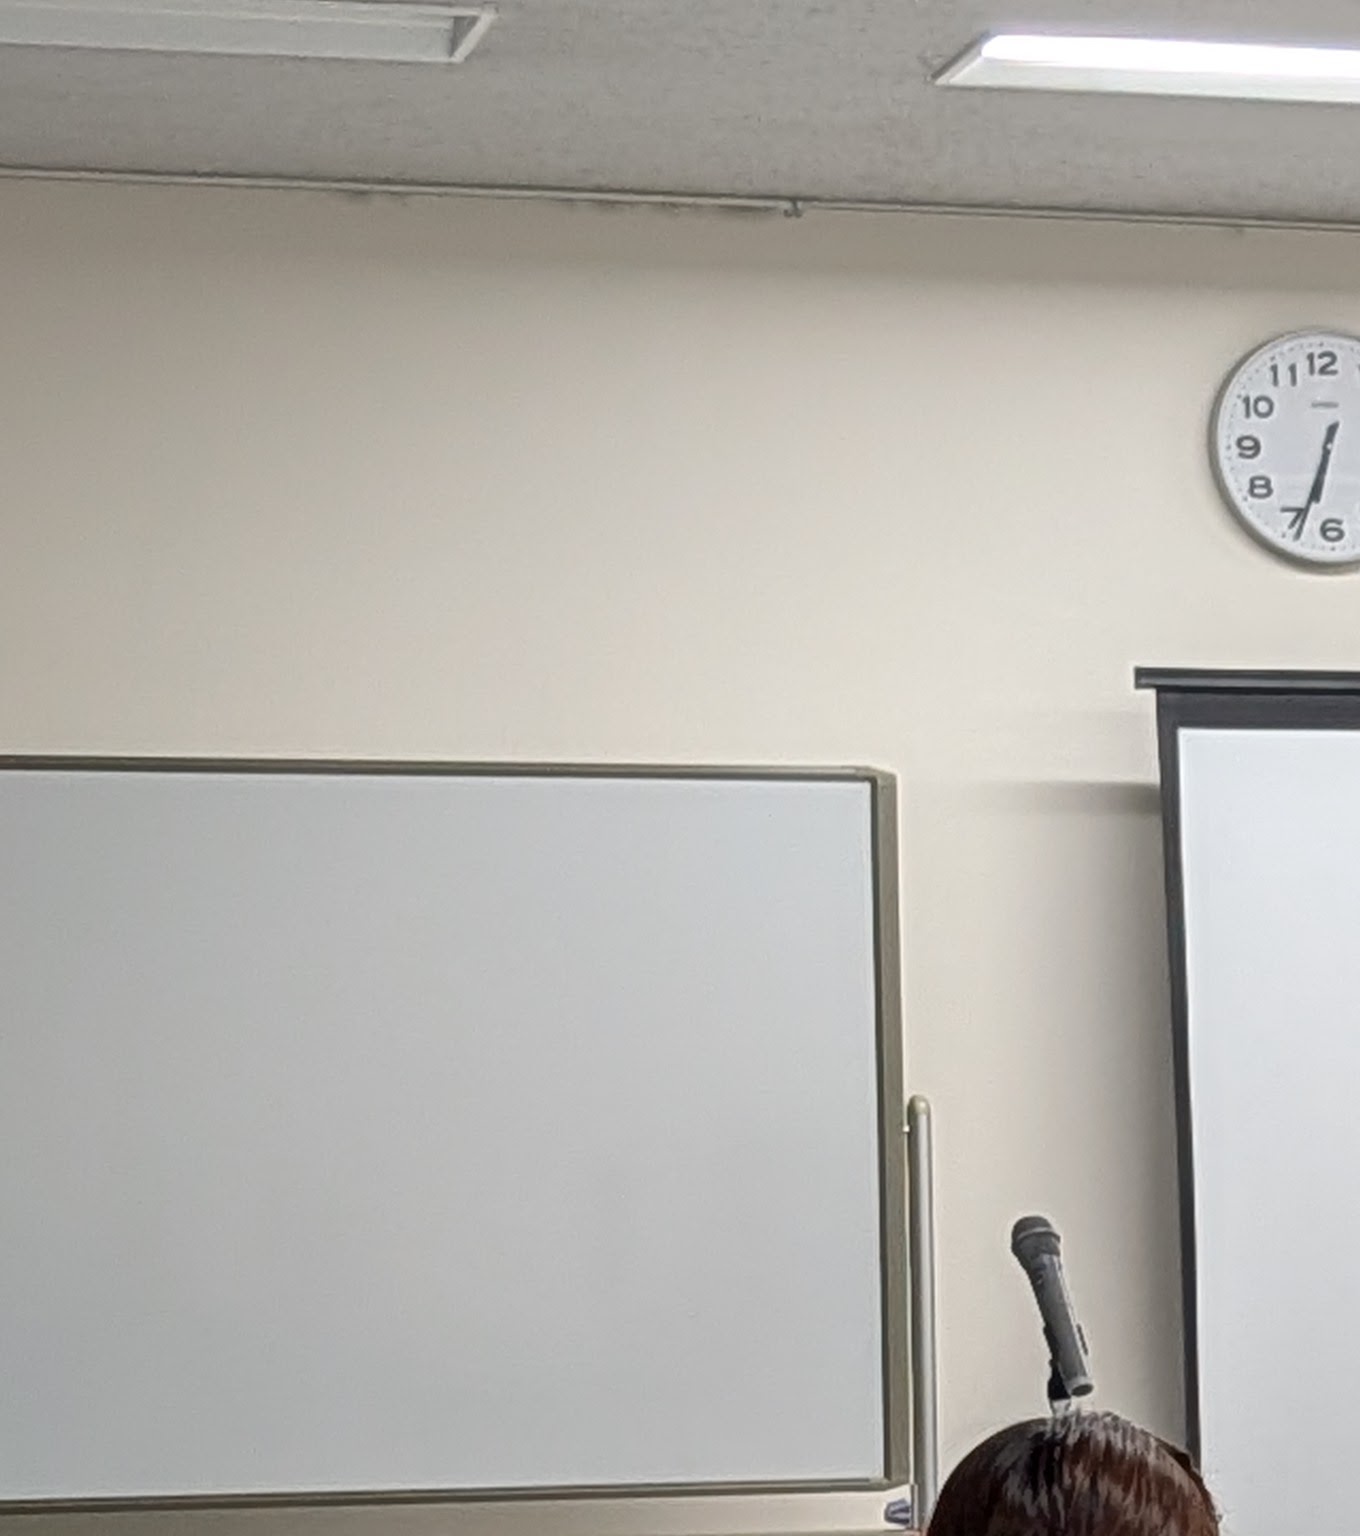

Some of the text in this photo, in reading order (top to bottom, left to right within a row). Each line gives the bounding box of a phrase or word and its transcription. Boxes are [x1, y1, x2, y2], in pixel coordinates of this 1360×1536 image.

[1270, 363, 1298, 387] 11
[1306, 350, 1339, 376] 12
[1242, 395, 1275, 419] 10
[1235, 434, 1262, 460] 9
[1248, 475, 1274, 499] 8
[1280, 506, 1305, 530] 7
[1319, 518, 1345, 542] 6
